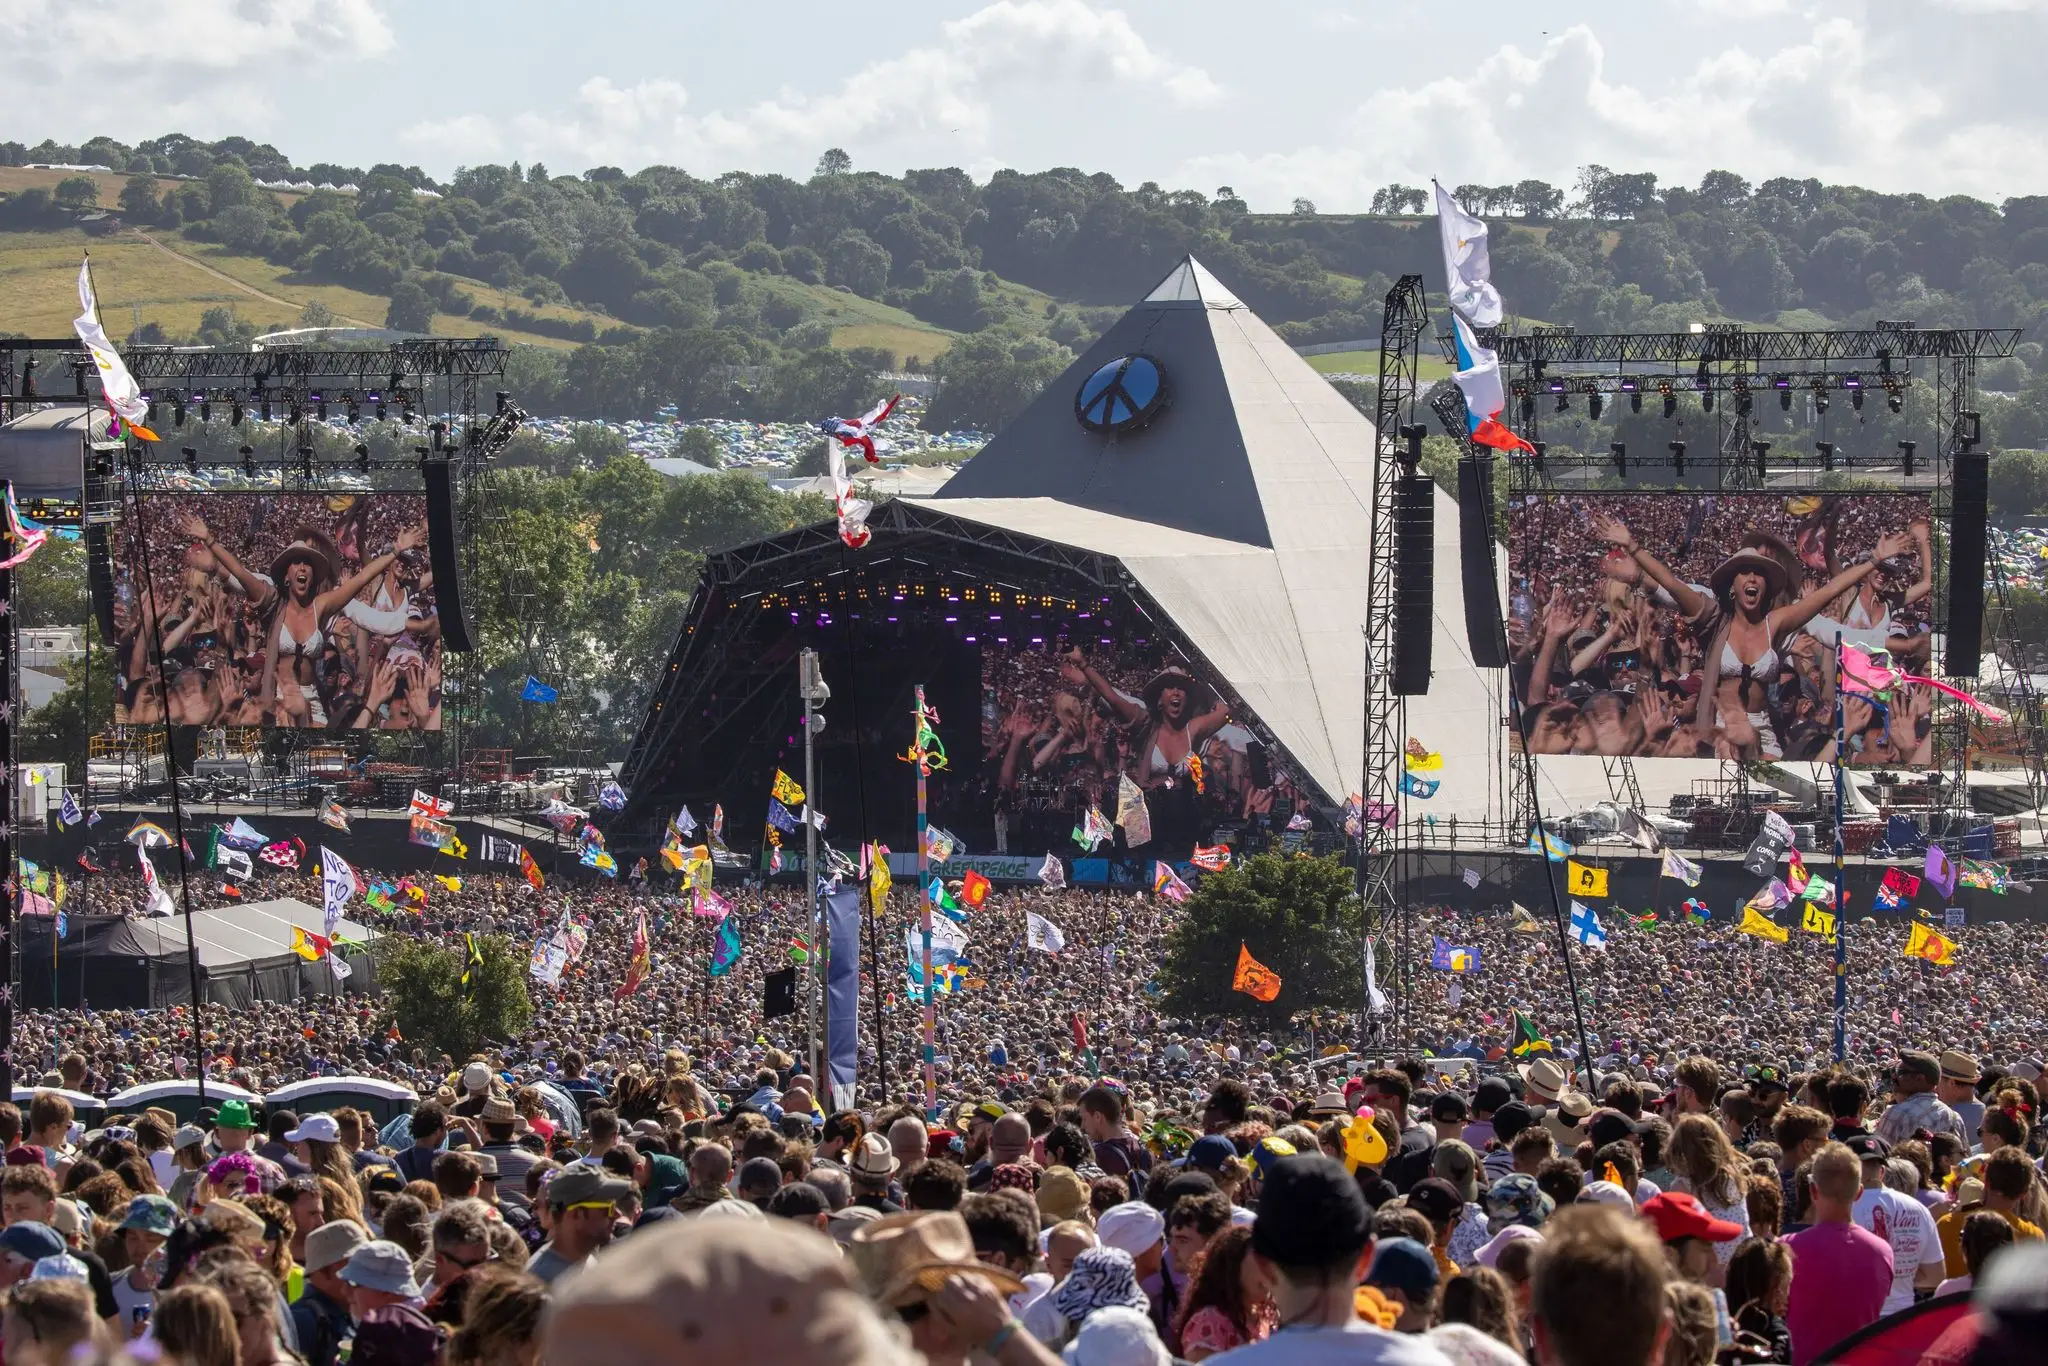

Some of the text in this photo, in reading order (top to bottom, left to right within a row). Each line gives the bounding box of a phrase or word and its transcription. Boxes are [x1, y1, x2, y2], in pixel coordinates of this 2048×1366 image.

[1769, 839, 1776, 847] IS
[929, 860, 1027, 878] GREENPEACE
[325, 879, 348, 900] TO
[1893, 1209, 1920, 1228] Vans
